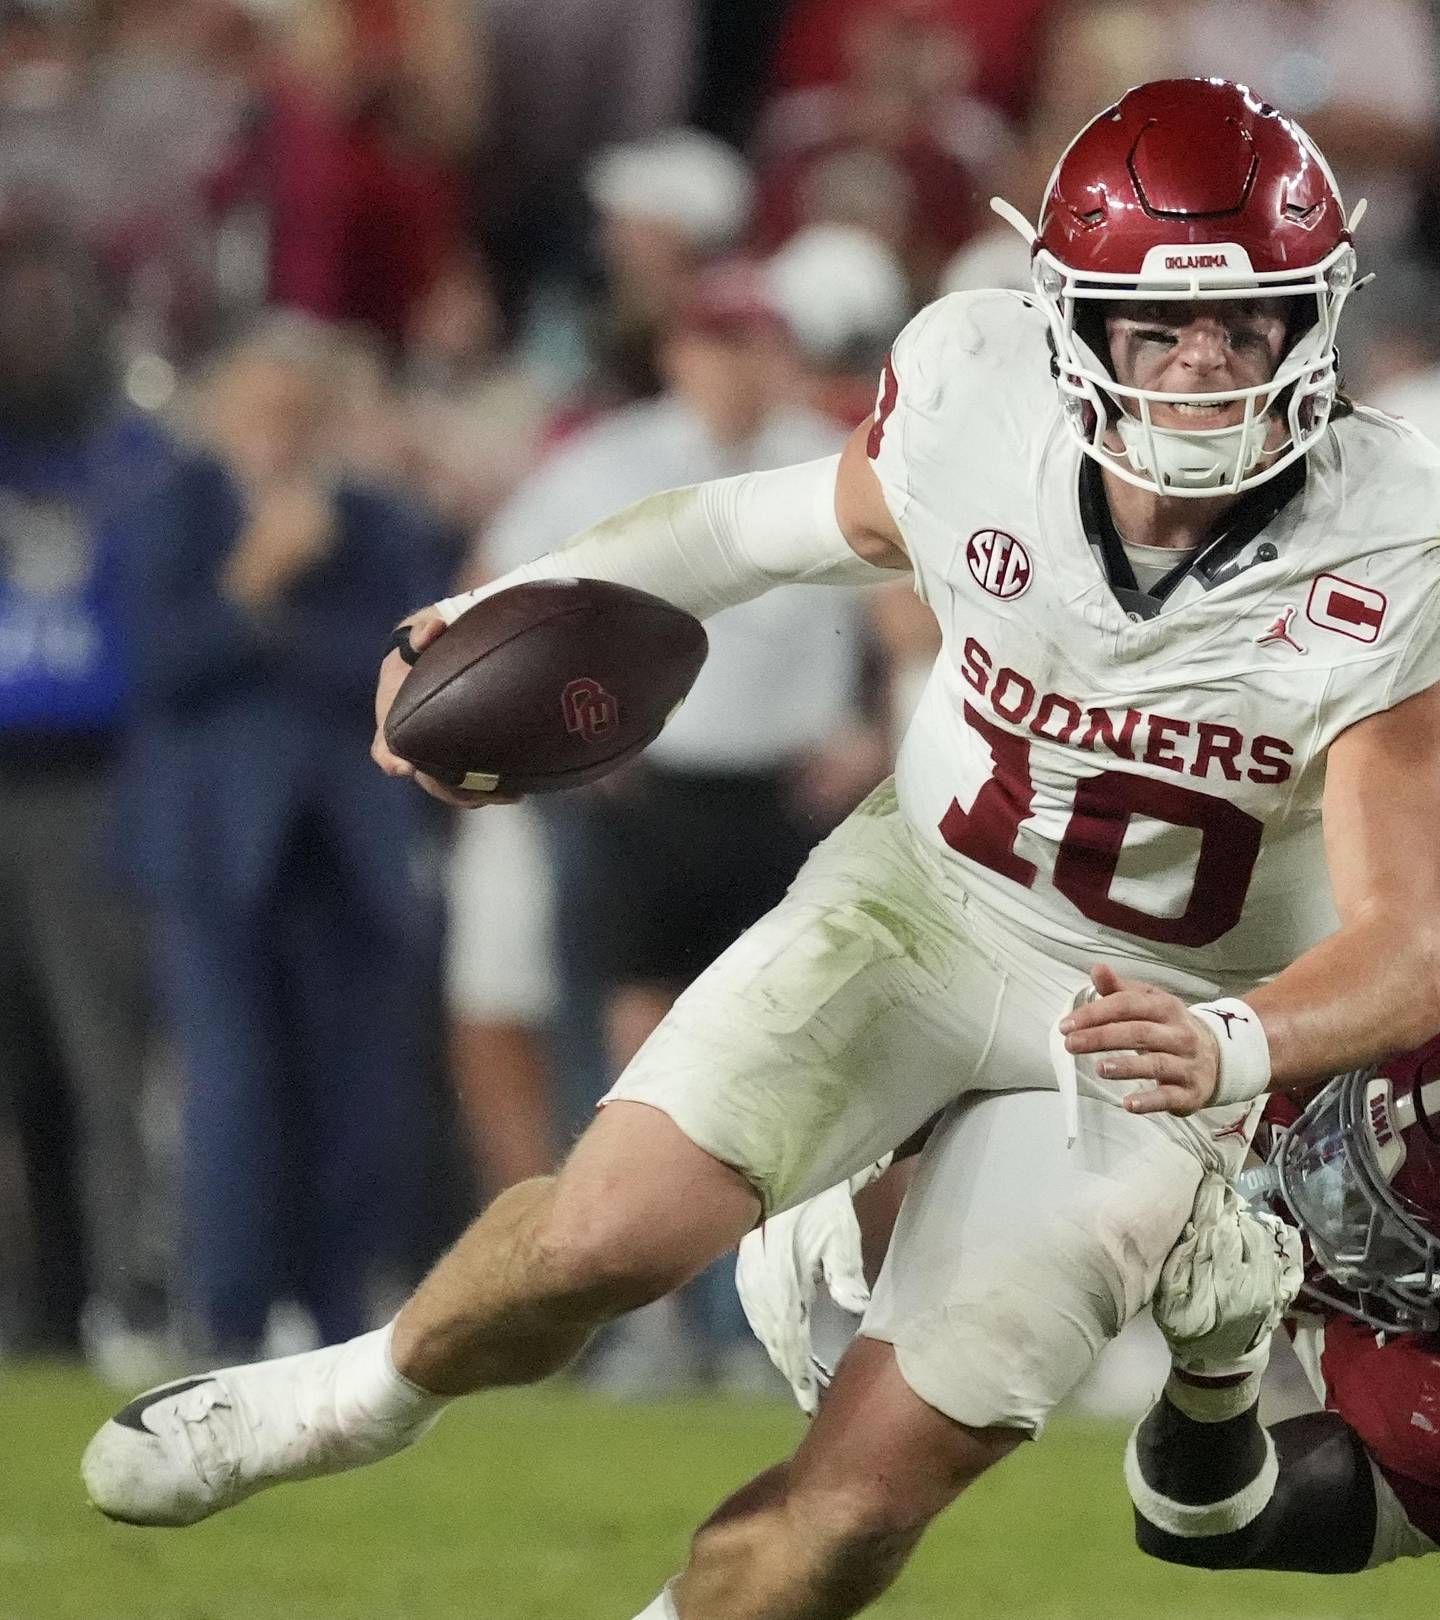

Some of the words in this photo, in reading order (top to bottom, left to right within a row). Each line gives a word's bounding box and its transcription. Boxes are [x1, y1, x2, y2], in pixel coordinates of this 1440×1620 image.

[1165, 255, 1227, 269] OKLAHOMA
[969, 532, 1027, 595] SEC
[1307, 573, 1386, 643] C
[961, 637, 1293, 784] SOONERS
[938, 699, 1264, 947] 10
